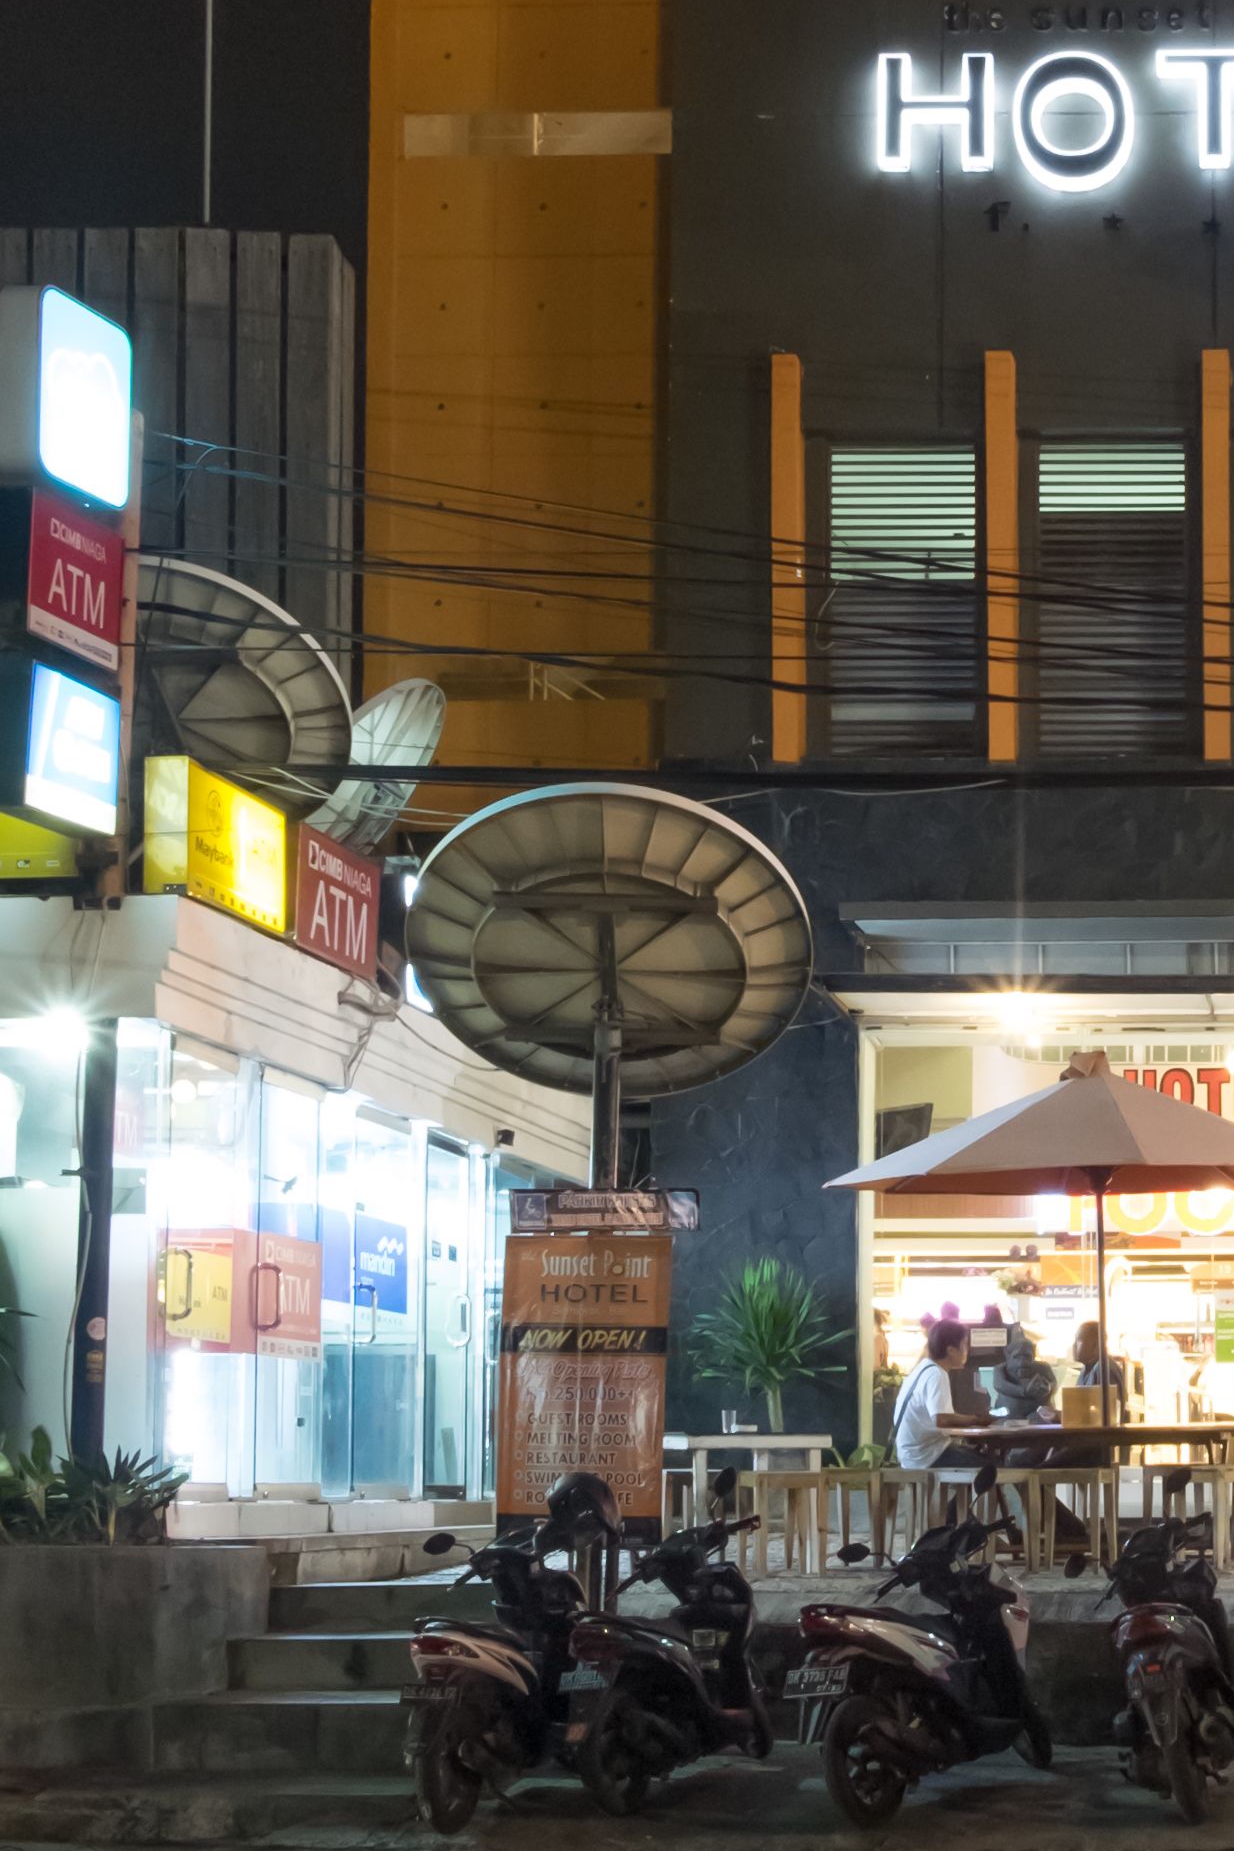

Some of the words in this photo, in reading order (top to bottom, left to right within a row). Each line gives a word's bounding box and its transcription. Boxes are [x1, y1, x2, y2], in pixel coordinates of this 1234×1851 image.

[59, 523, 81, 550] CIMB
[47, 557, 106, 629] ATM
[319, 851, 343, 881] CIMB
[343, 863, 373, 898] NIAGA
[309, 880, 368, 965] ATM
[541, 1249, 597, 1278] Sunset
[211, 1285, 229, 1302] ATM
[539, 1283, 650, 1304] HOTEL
[519, 1328, 573, 1350] NOW
[576, 1328, 648, 1350] OPEN!
[527, 1412, 573, 1426] GUEST
[578, 1412, 628, 1426] ROOMS
[525, 1451, 617, 1466] RESTAURANT
[606, 1471, 643, 1486] POOL
